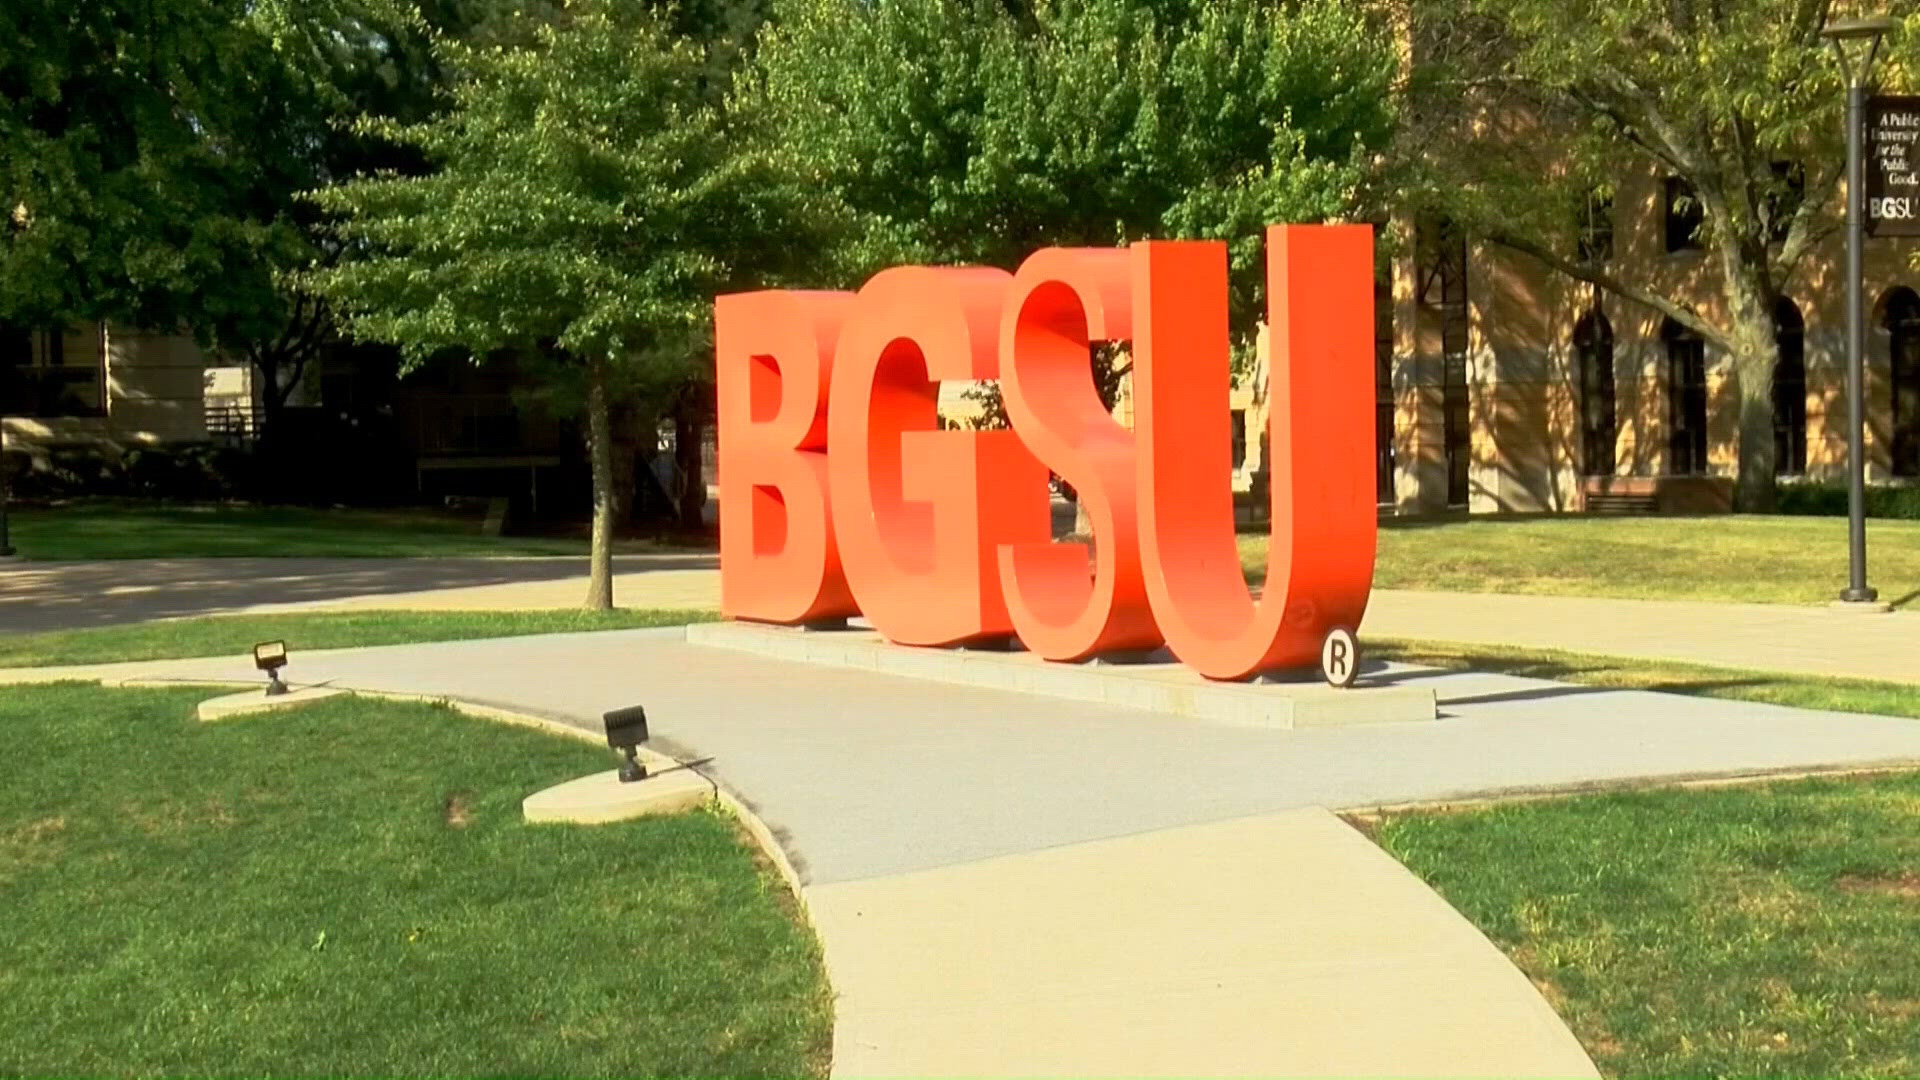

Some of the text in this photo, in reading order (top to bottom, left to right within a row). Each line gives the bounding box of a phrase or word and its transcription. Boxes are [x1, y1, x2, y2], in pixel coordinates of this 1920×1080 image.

[1890, 112, 1919, 126] Public
[1871, 127, 1919, 146] University
[1873, 143, 1905, 159] for the
[1880, 158, 1908, 170] Public
[1870, 197, 1919, 218] BGSU
[716, 224, 1377, 681] BGSU
